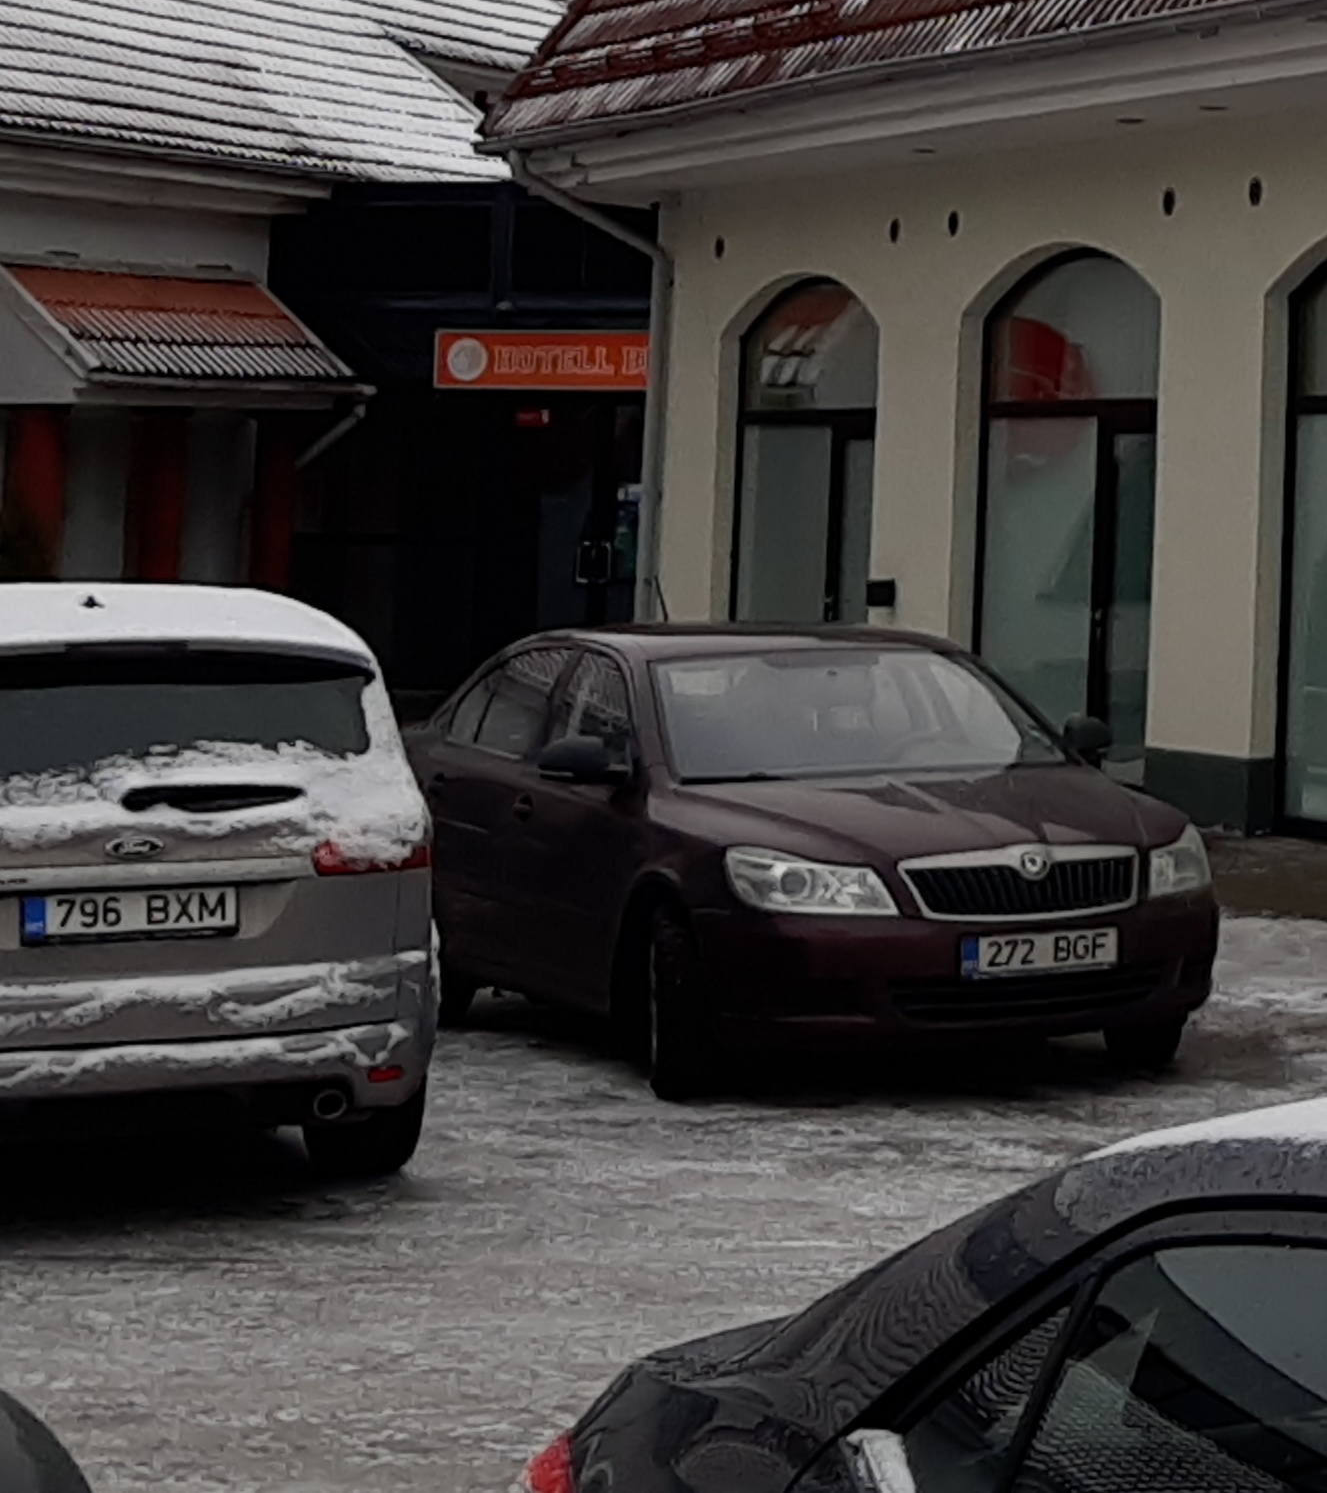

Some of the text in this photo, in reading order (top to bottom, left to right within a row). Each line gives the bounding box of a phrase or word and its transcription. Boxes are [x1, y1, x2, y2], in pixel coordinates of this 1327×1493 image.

[494, 345, 615, 375] HOTELL
[56, 892, 226, 928] 796 BXM
[987, 933, 1110, 967] 272 BGF
